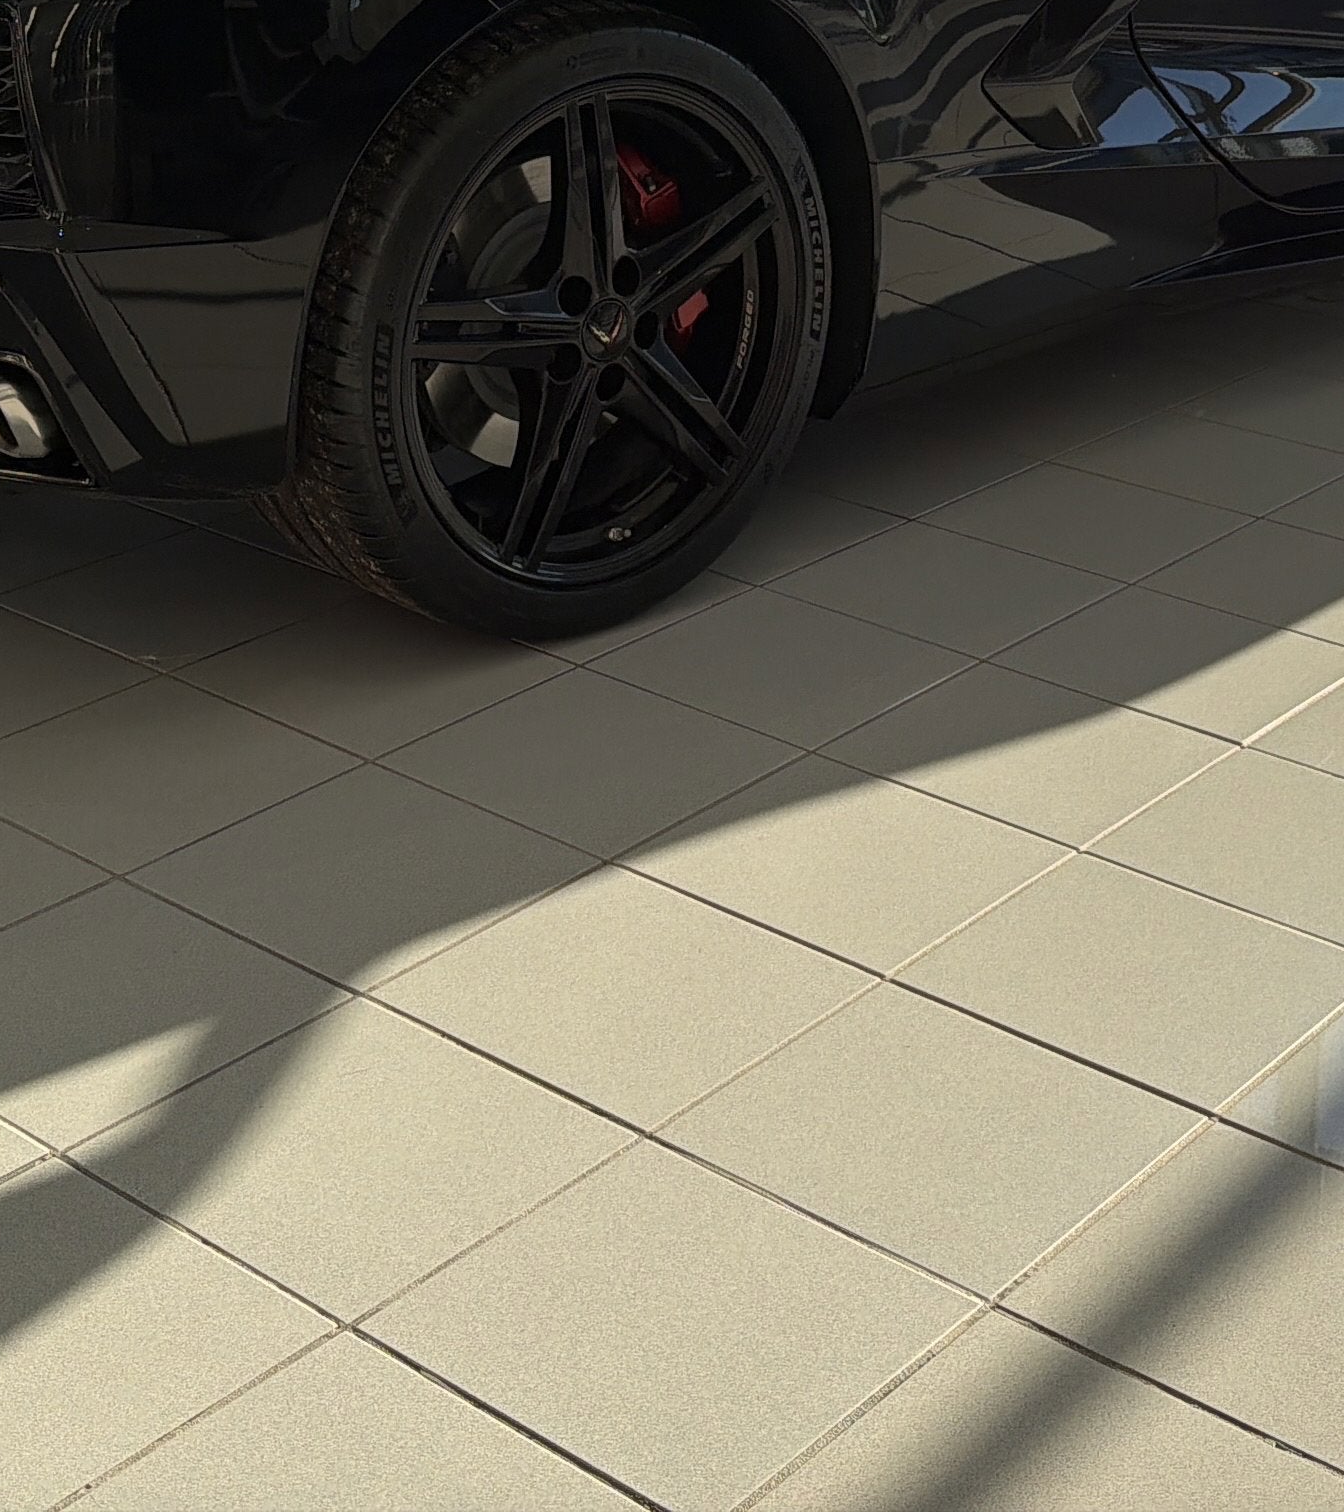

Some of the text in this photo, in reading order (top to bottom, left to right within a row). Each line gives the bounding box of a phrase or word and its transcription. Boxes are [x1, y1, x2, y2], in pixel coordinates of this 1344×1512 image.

[736, 288, 755, 370] FORGED
[804, 195, 825, 330] MICHELIN
[373, 330, 403, 486] MICHELIN
